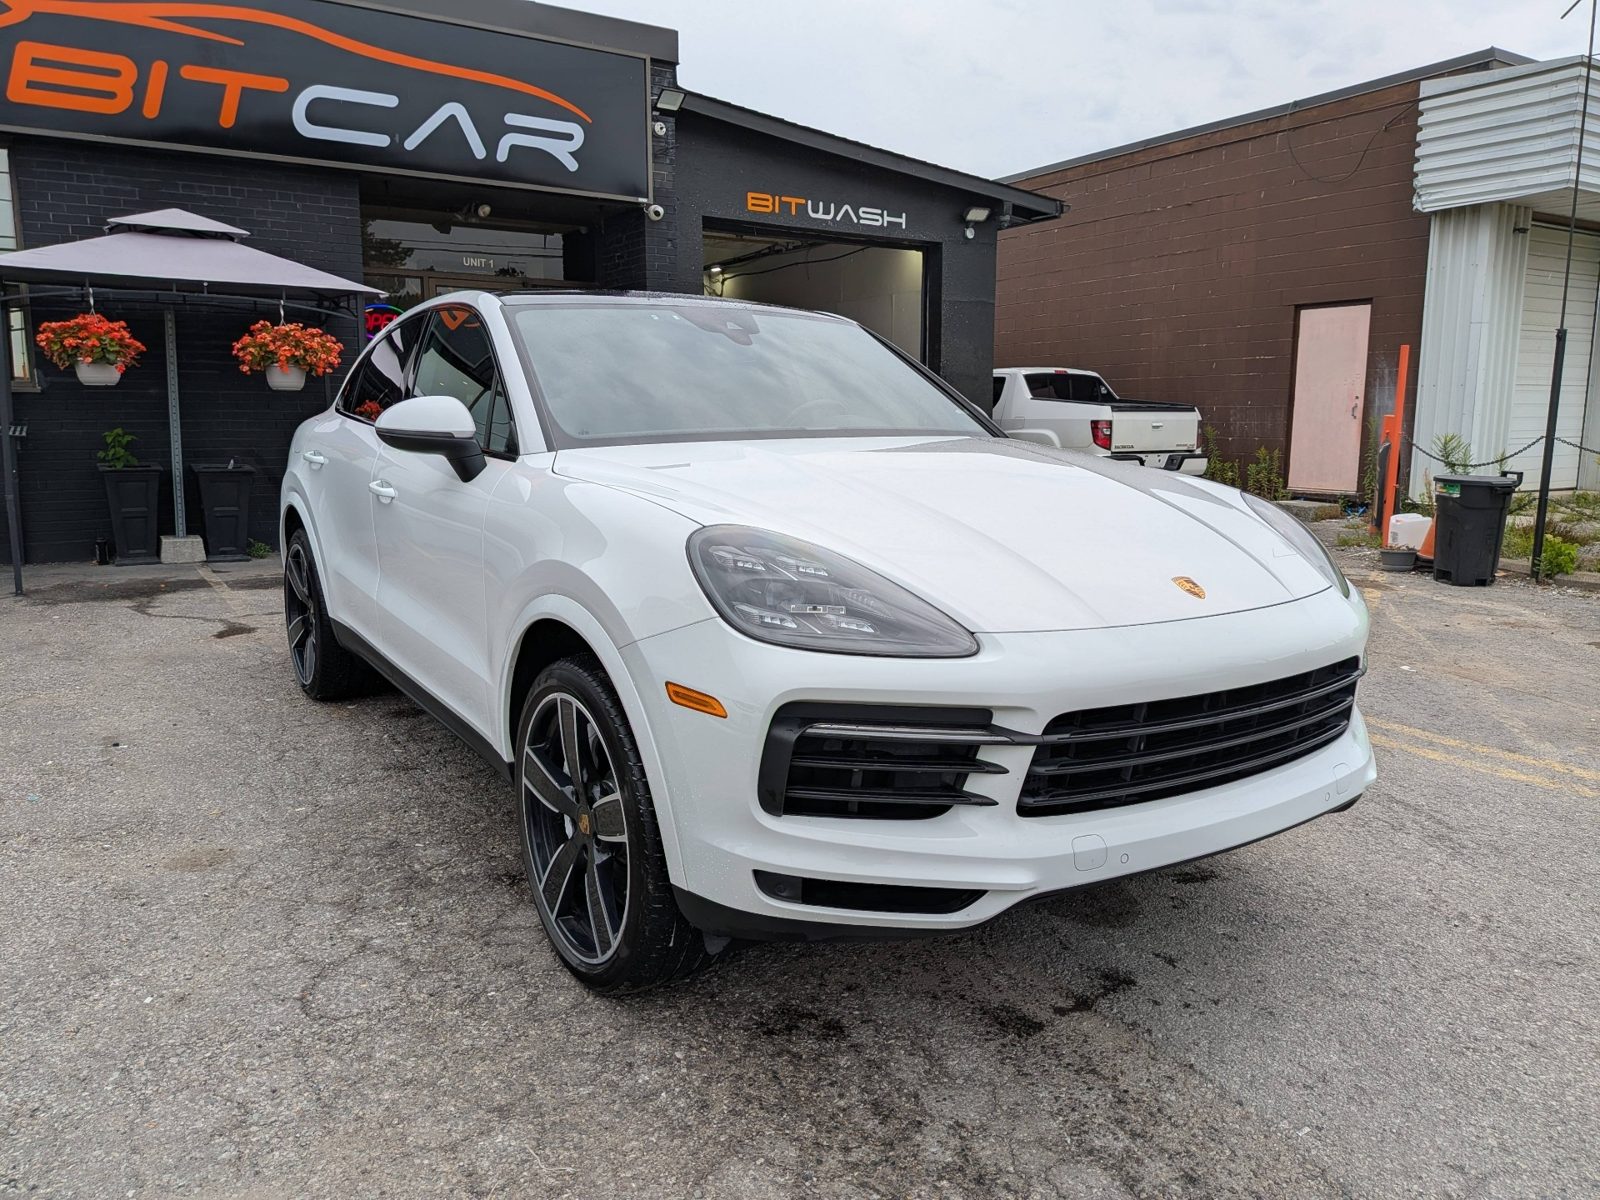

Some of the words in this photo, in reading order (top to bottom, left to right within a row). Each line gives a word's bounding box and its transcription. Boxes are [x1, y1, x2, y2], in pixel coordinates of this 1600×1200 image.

[463, 256, 487, 268] UNIT
[489, 259, 494, 268] 1
[364, 313, 398, 331] OPE
